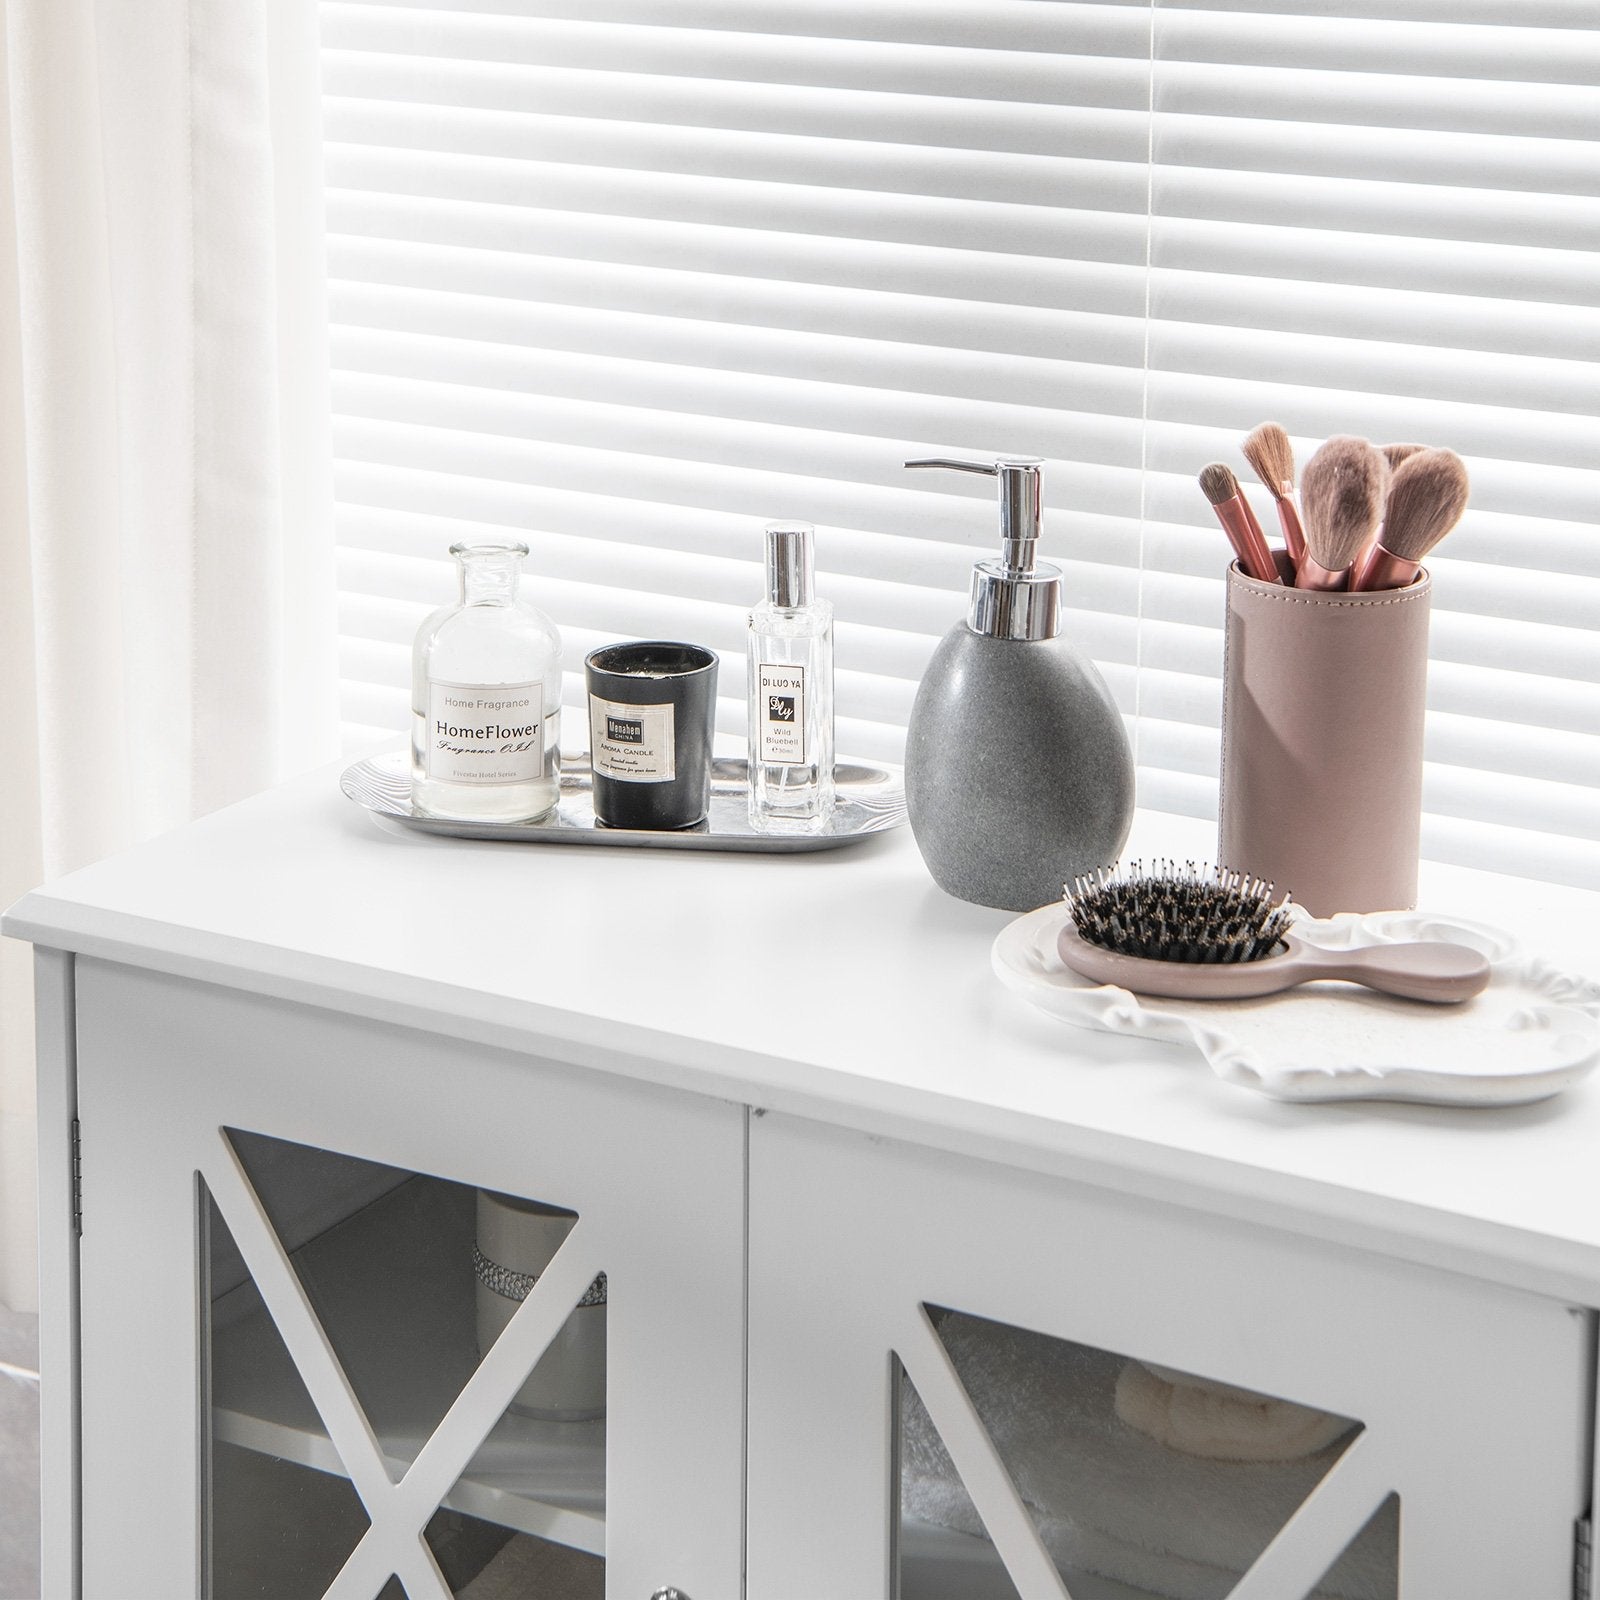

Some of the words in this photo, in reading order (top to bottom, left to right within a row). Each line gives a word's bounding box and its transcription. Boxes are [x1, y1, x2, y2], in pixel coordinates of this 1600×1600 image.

[762, 678, 771, 687] DI
[773, 679, 788, 688] LUO
[790, 680, 801, 689] YA
[445, 697, 474, 709] Home
[477, 698, 530, 711] Fragrance
[437, 720, 539, 739] HomeFlower
[609, 720, 641, 736] Menahem
[773, 728, 791, 736] Wild
[614, 733, 634, 741] CHINA
[766, 736, 799, 745] Bluebell
[436, 740, 496, 755] Fragrance
[453, 769, 478, 778] Fivestar
[479, 771, 497, 779] Hotel
